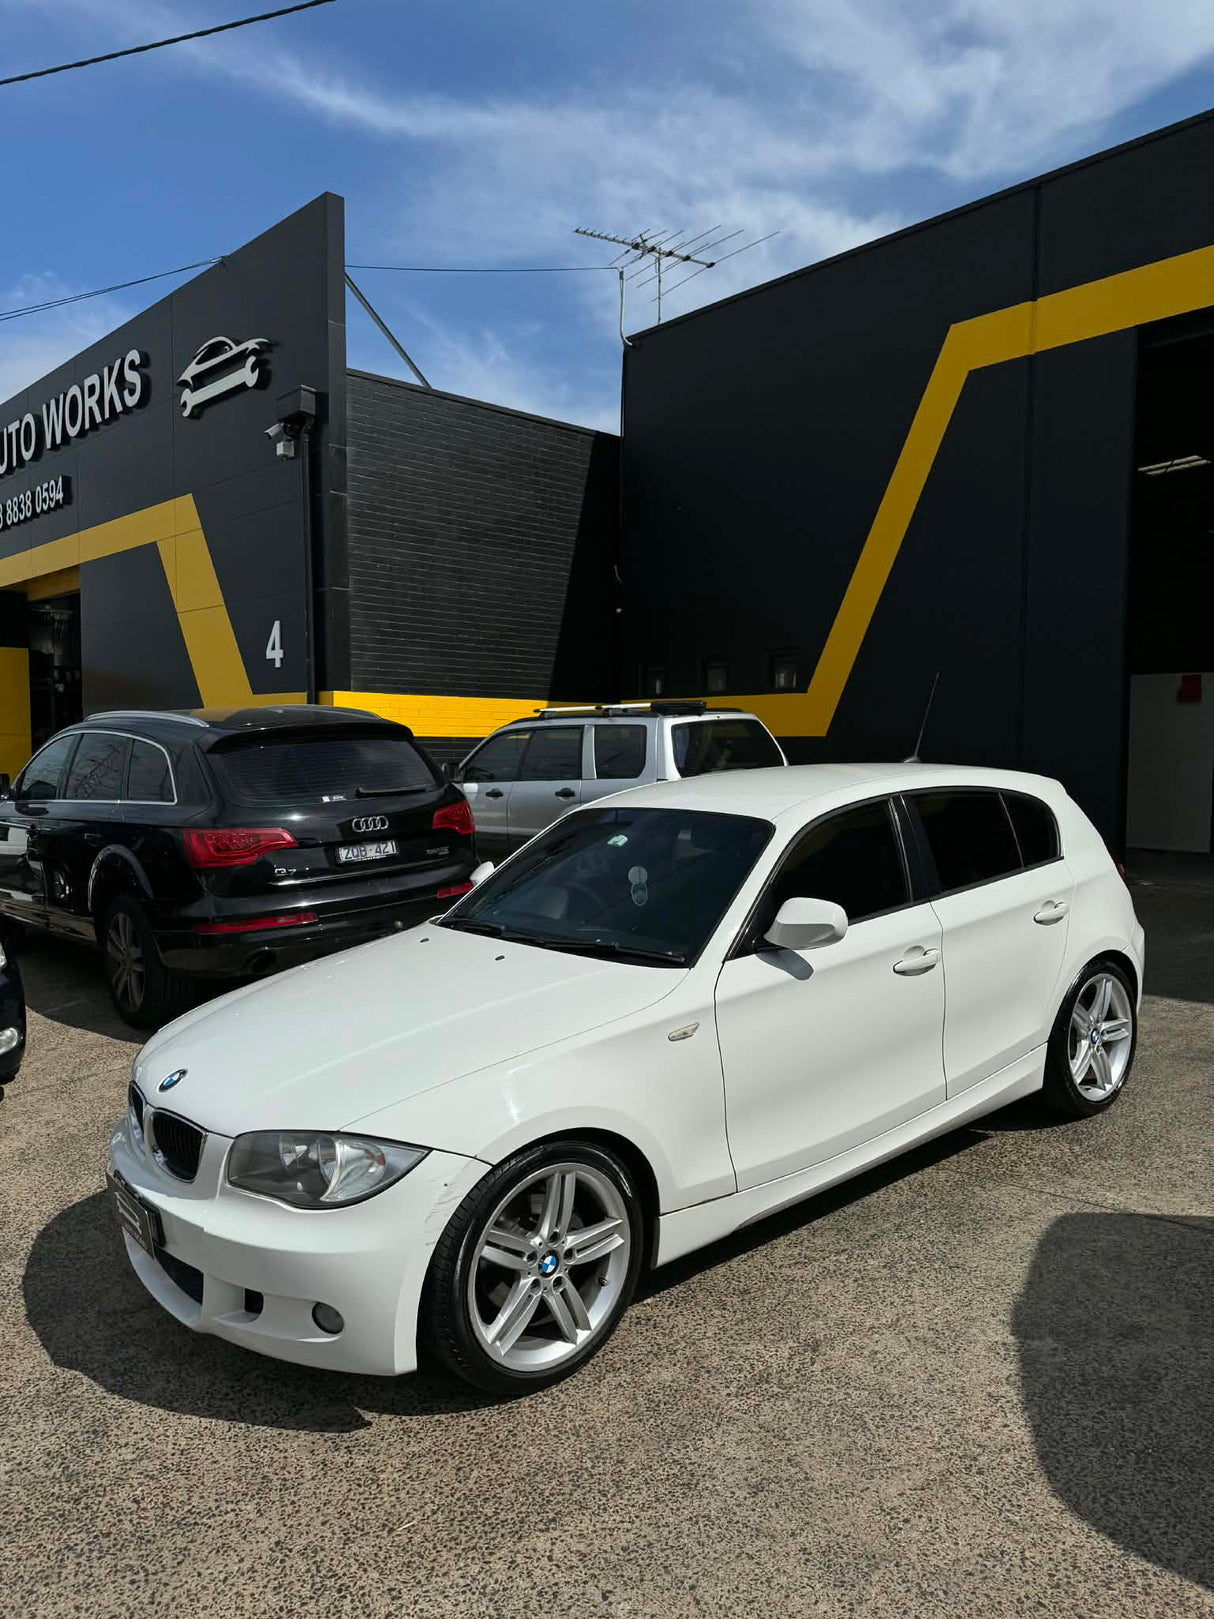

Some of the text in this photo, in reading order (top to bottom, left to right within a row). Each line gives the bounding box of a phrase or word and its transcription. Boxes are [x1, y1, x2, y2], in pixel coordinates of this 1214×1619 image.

[42, 349, 142, 450] WORKS
[6, 490, 32, 526] 8838
[35, 475, 64, 514] 0594
[266, 620, 284, 668] 4
